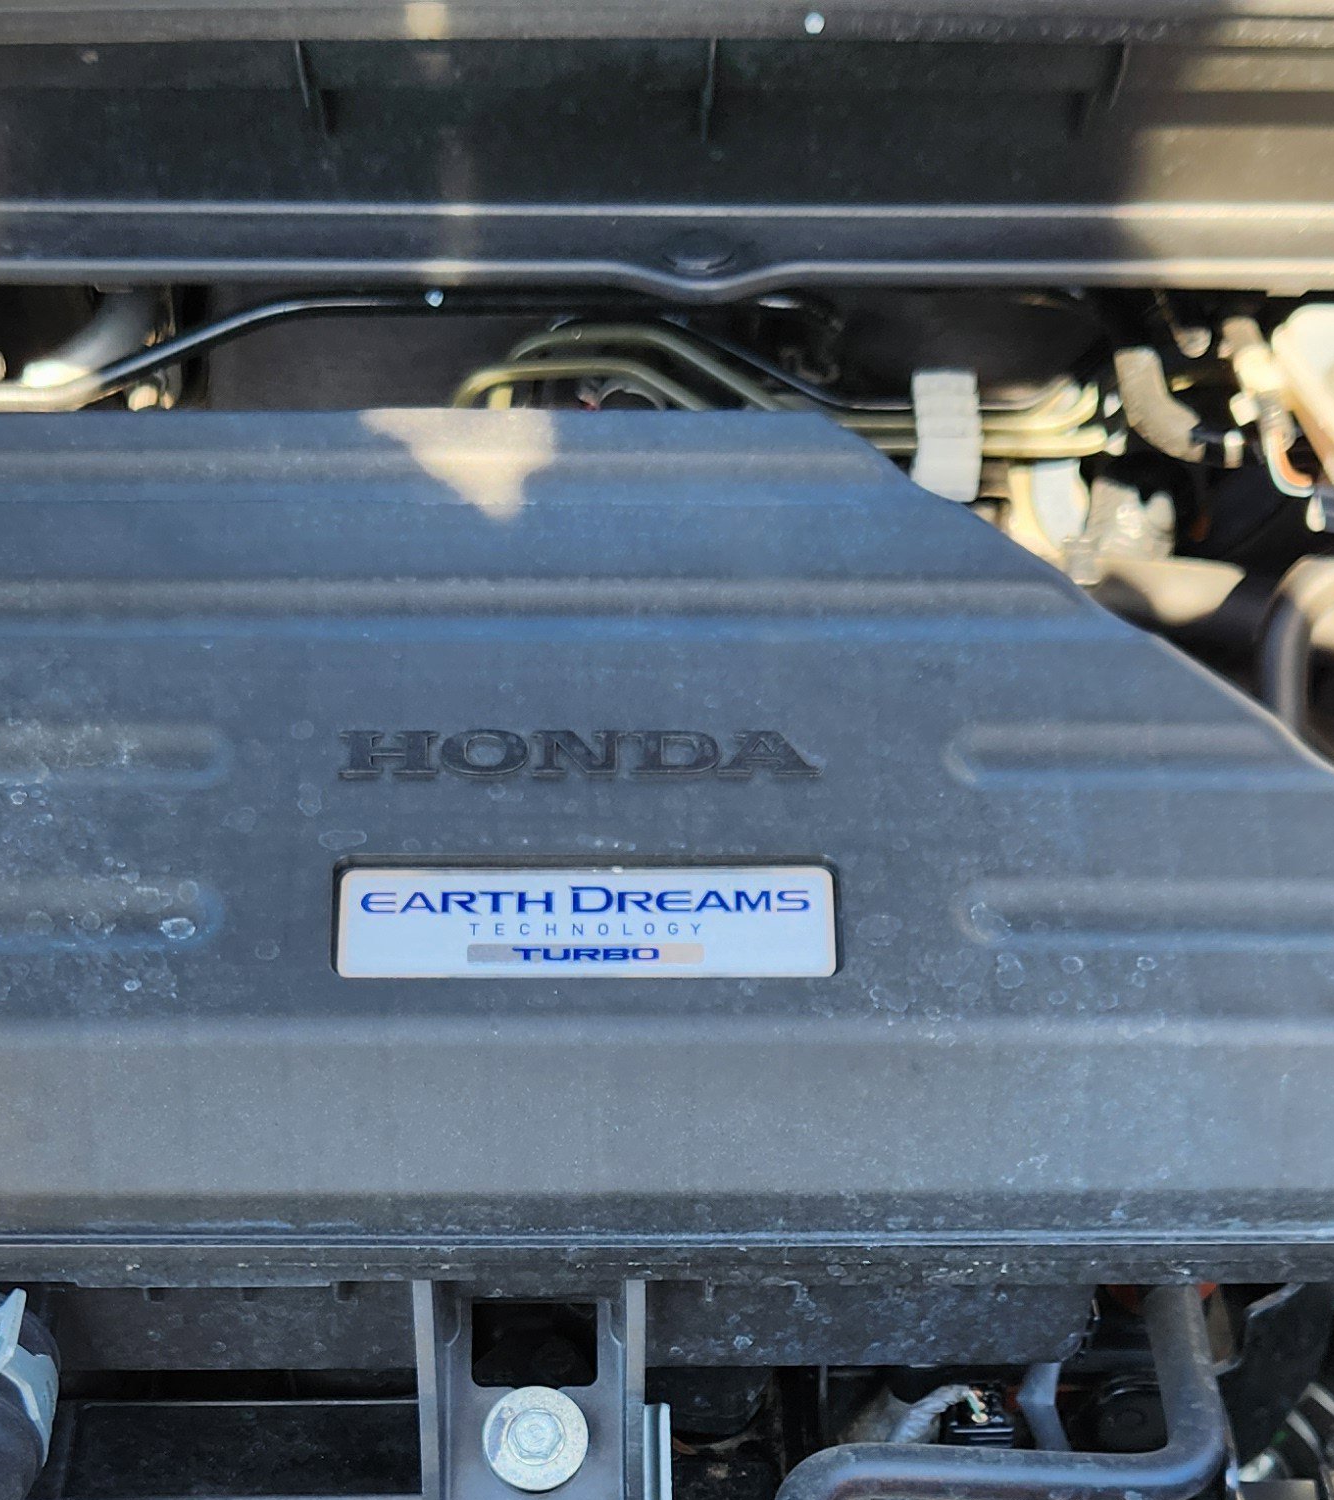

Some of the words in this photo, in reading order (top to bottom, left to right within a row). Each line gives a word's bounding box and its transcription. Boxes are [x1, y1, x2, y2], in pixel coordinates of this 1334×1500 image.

[337, 729, 826, 779] HONDA
[360, 889, 554, 915] EARTH
[568, 885, 812, 915] DREAMS
[469, 923, 704, 937] TECHNOLOGY
[512, 947, 660, 962] TURBO
